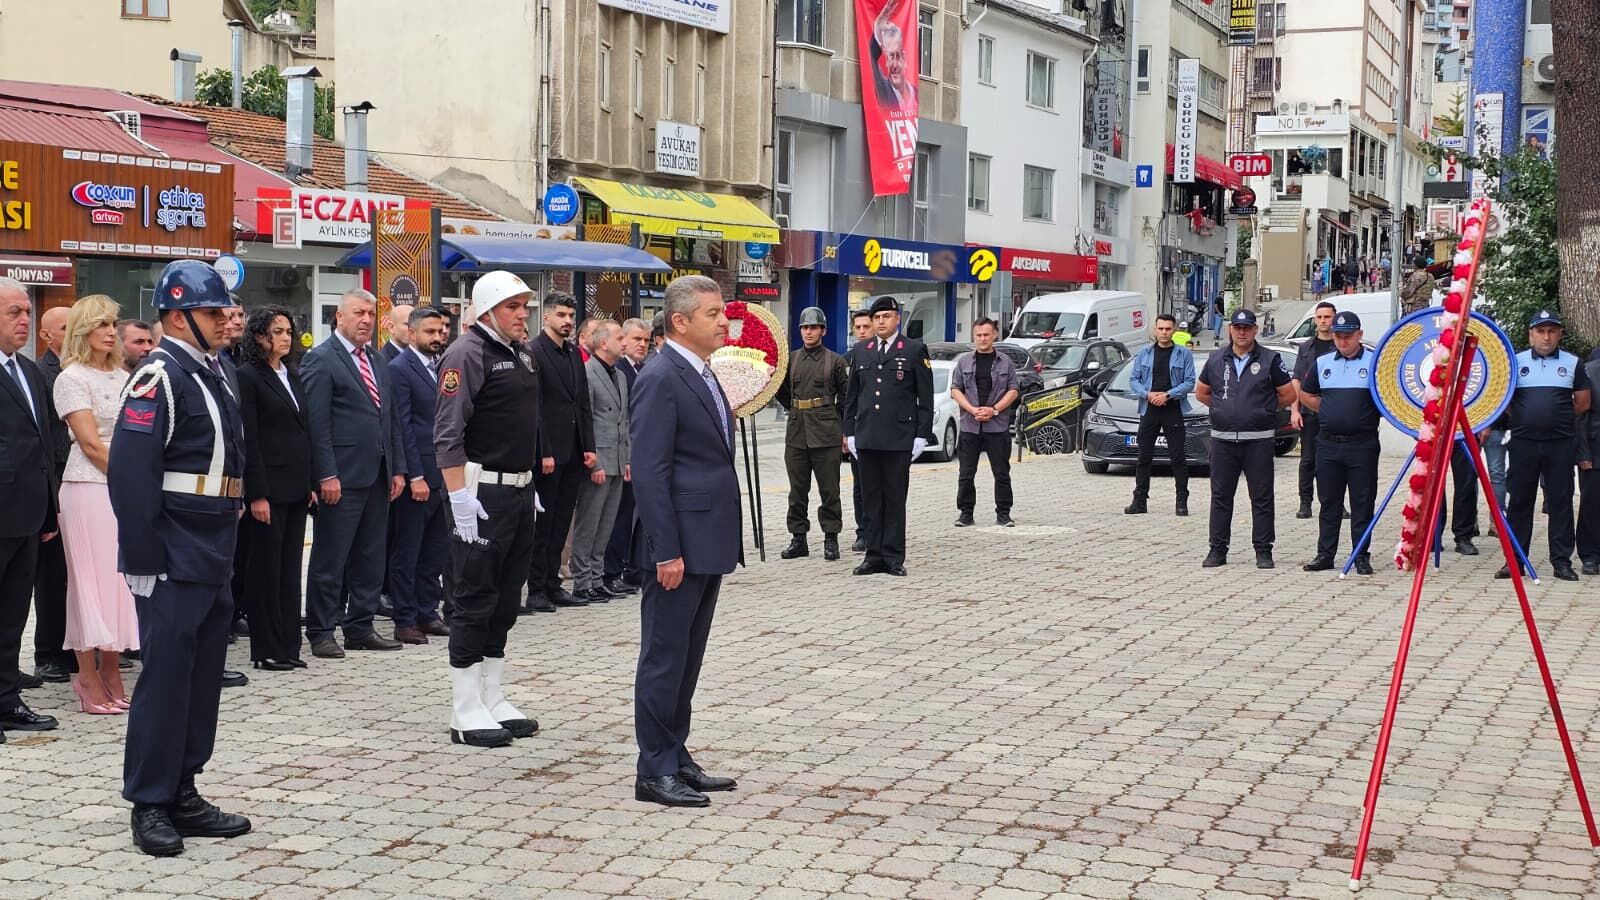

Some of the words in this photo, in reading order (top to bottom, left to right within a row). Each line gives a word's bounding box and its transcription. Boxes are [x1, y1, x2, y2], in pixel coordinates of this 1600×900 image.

[1279, 118, 1293, 128] NO
[661, 136, 696, 153] AVUKAT
[1233, 156, 1267, 173] BİM
[160, 185, 205, 208] ethica
[157, 207, 206, 231] sigorta
[319, 225, 346, 236] AYLİN
[881, 248, 931, 270] TURKCELL
[1011, 256, 1051, 272] AKBANK
